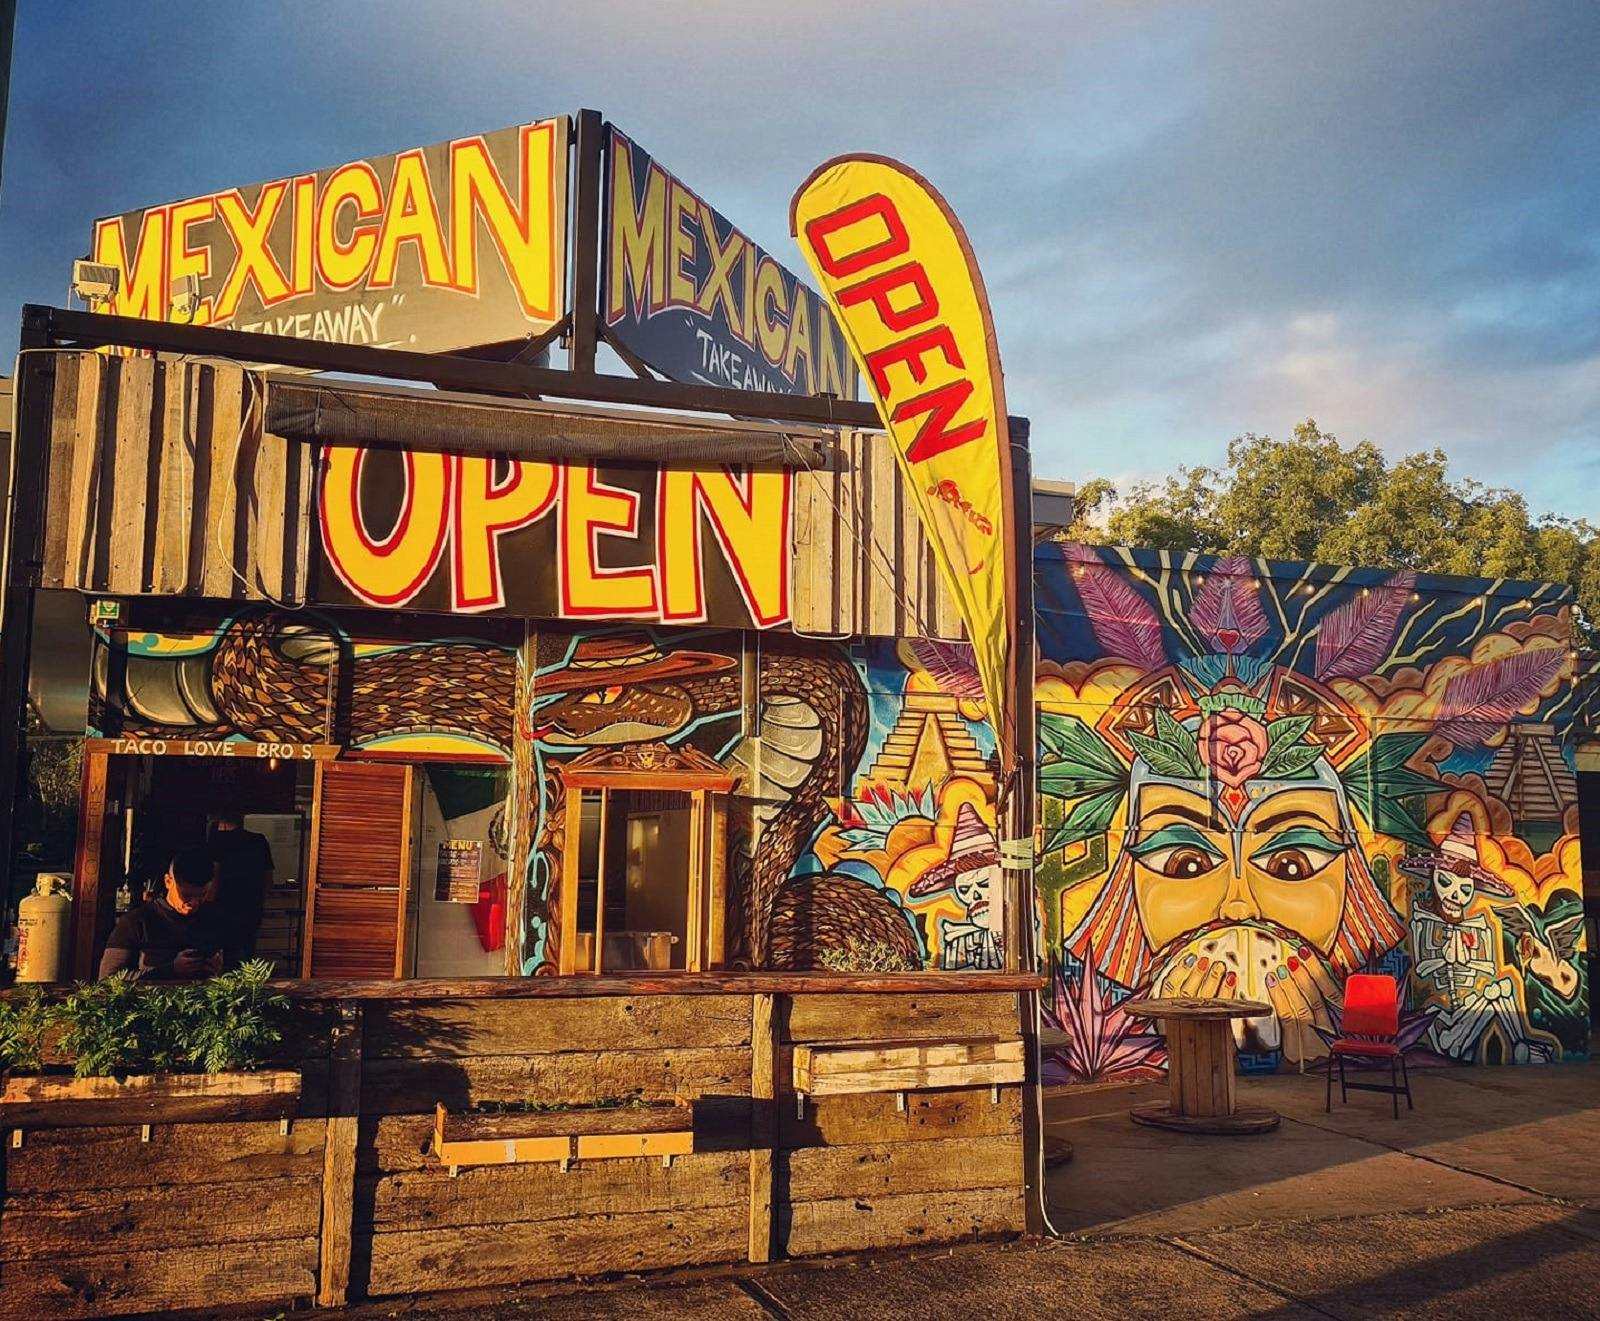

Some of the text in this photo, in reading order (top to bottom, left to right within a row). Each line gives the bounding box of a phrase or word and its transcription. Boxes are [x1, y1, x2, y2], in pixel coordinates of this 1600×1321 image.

[94, 119, 558, 357] MEXICAN
[805, 192, 988, 464] OPEN
[319, 443, 793, 629] OPEN
[111, 739, 167, 755] TACO
[184, 741, 236, 757] LOVE
[443, 839, 473, 851] MENU
